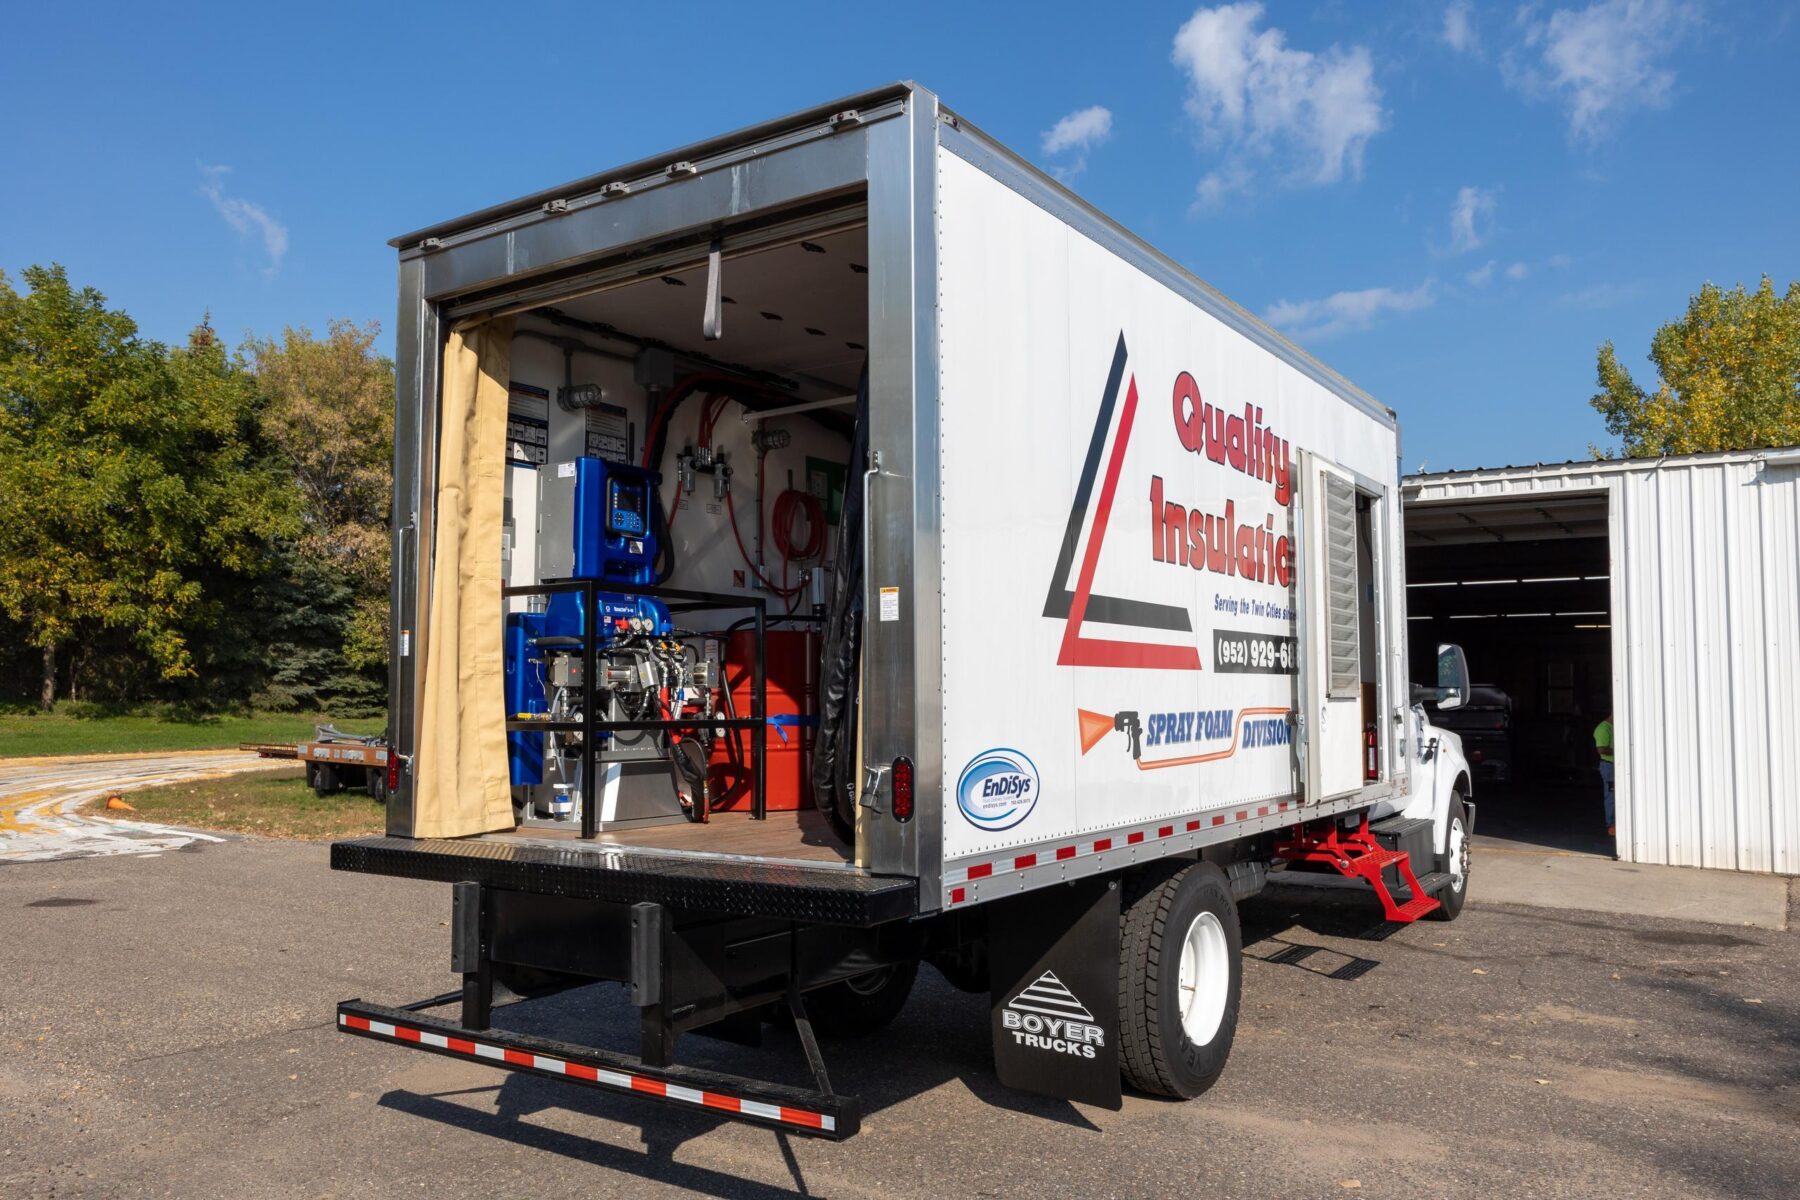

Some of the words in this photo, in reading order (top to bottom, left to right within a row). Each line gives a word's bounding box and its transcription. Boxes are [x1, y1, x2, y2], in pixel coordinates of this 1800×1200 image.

[1173, 371, 1290, 507] Quality
[1214, 593, 1238, 616] Serving
[1240, 598, 1250, 615] the
[1251, 599, 1264, 617] Twin
[1266, 602, 1282, 620] Cities
[1218, 638, 1248, 667] (952)
[1146, 711, 1195, 747] SPRAY
[1195, 709, 1234, 741] FOAM
[1242, 718, 1293, 749] DIVISION
[982, 775, 1031, 798] EnDiSys
[1002, 1009, 1105, 1046] BOYER
[1012, 1031, 1096, 1059] TRUCKS
